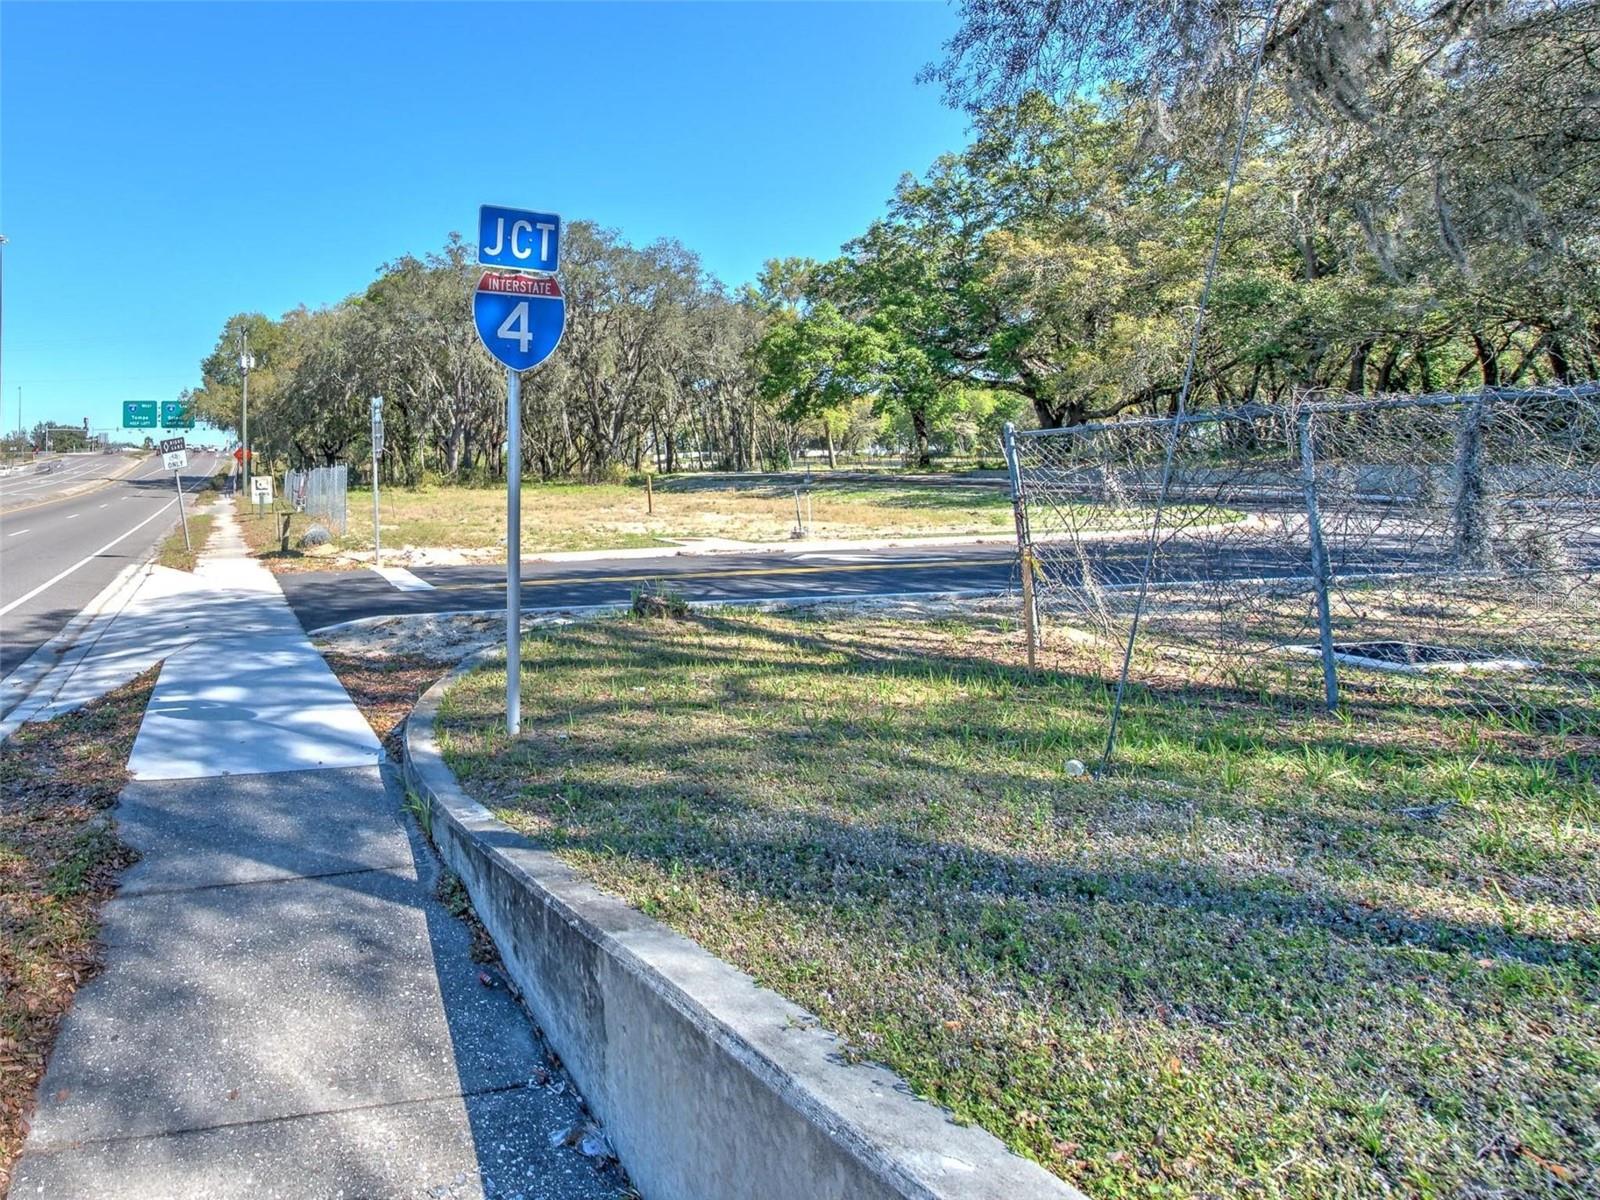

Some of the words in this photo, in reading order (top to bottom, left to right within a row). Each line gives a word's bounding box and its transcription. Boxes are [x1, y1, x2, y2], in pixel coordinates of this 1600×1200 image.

[484, 218, 555, 261] JCT
[488, 277, 552, 295] INTERSTATE
[497, 302, 533, 353] 4
[168, 460, 184, 469] ONLY
